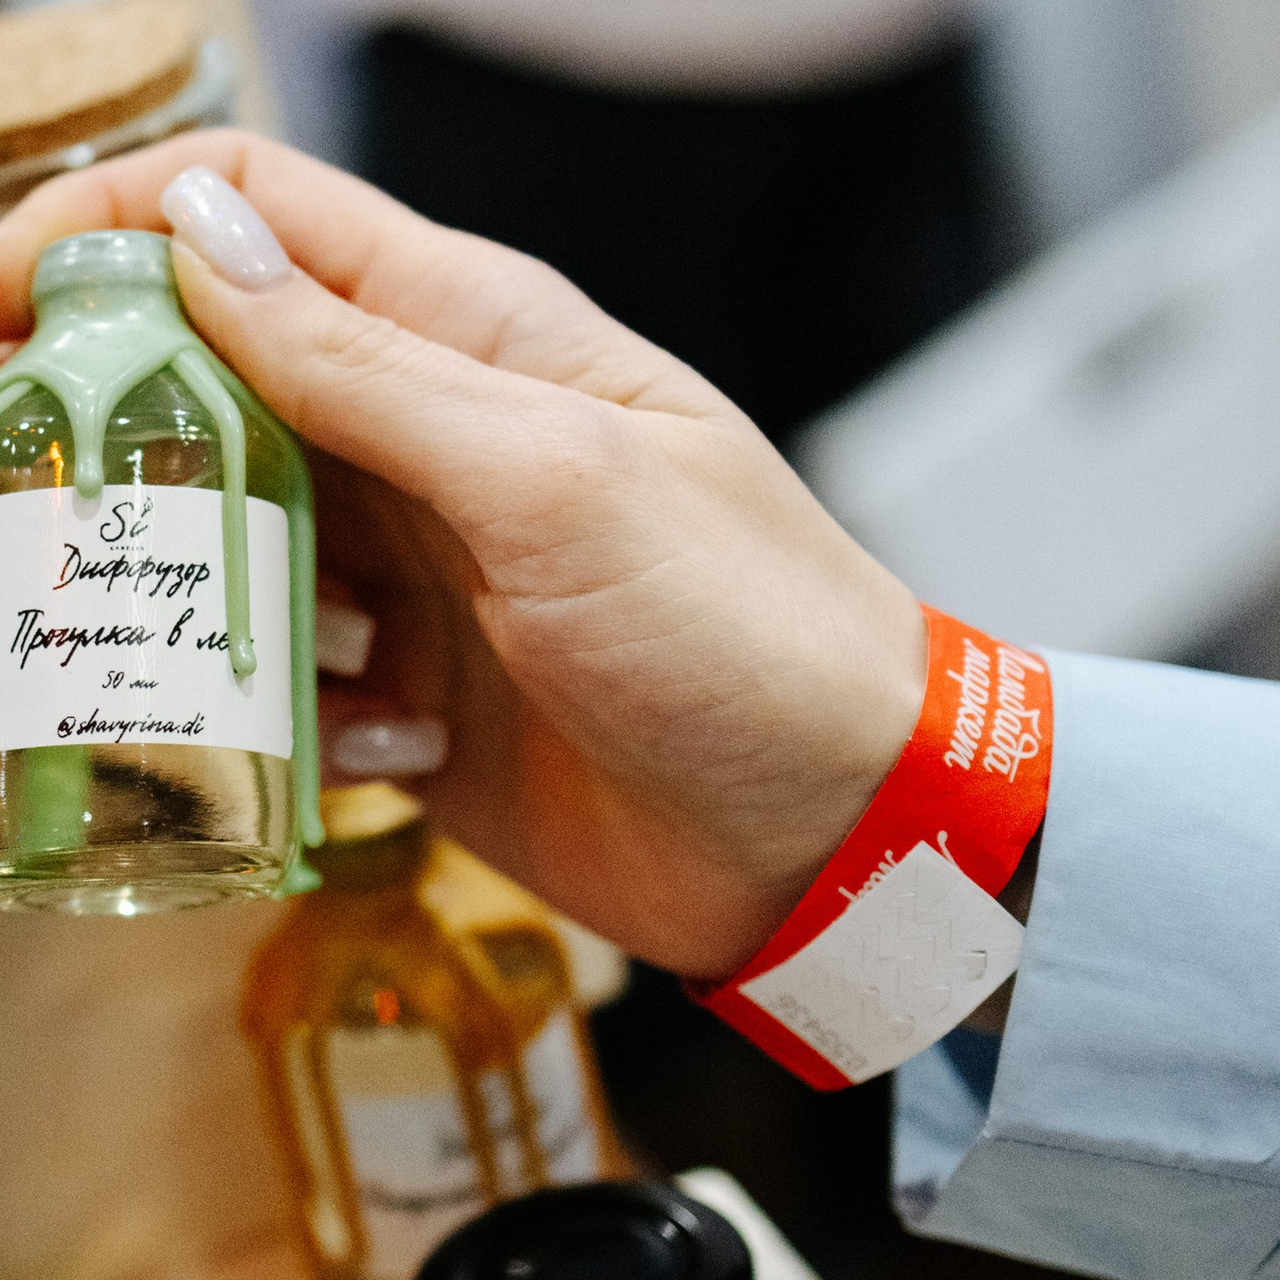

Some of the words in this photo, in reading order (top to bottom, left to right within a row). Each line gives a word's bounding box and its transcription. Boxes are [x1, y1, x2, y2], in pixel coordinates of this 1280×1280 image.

[53, 543, 210, 598] Диффузор
[11, 608, 156, 670] Прогулка
[102, 670, 124, 689] 50
[943, 637, 991, 771] маркет
[57, 708, 205, 744] @shavyrina.di
